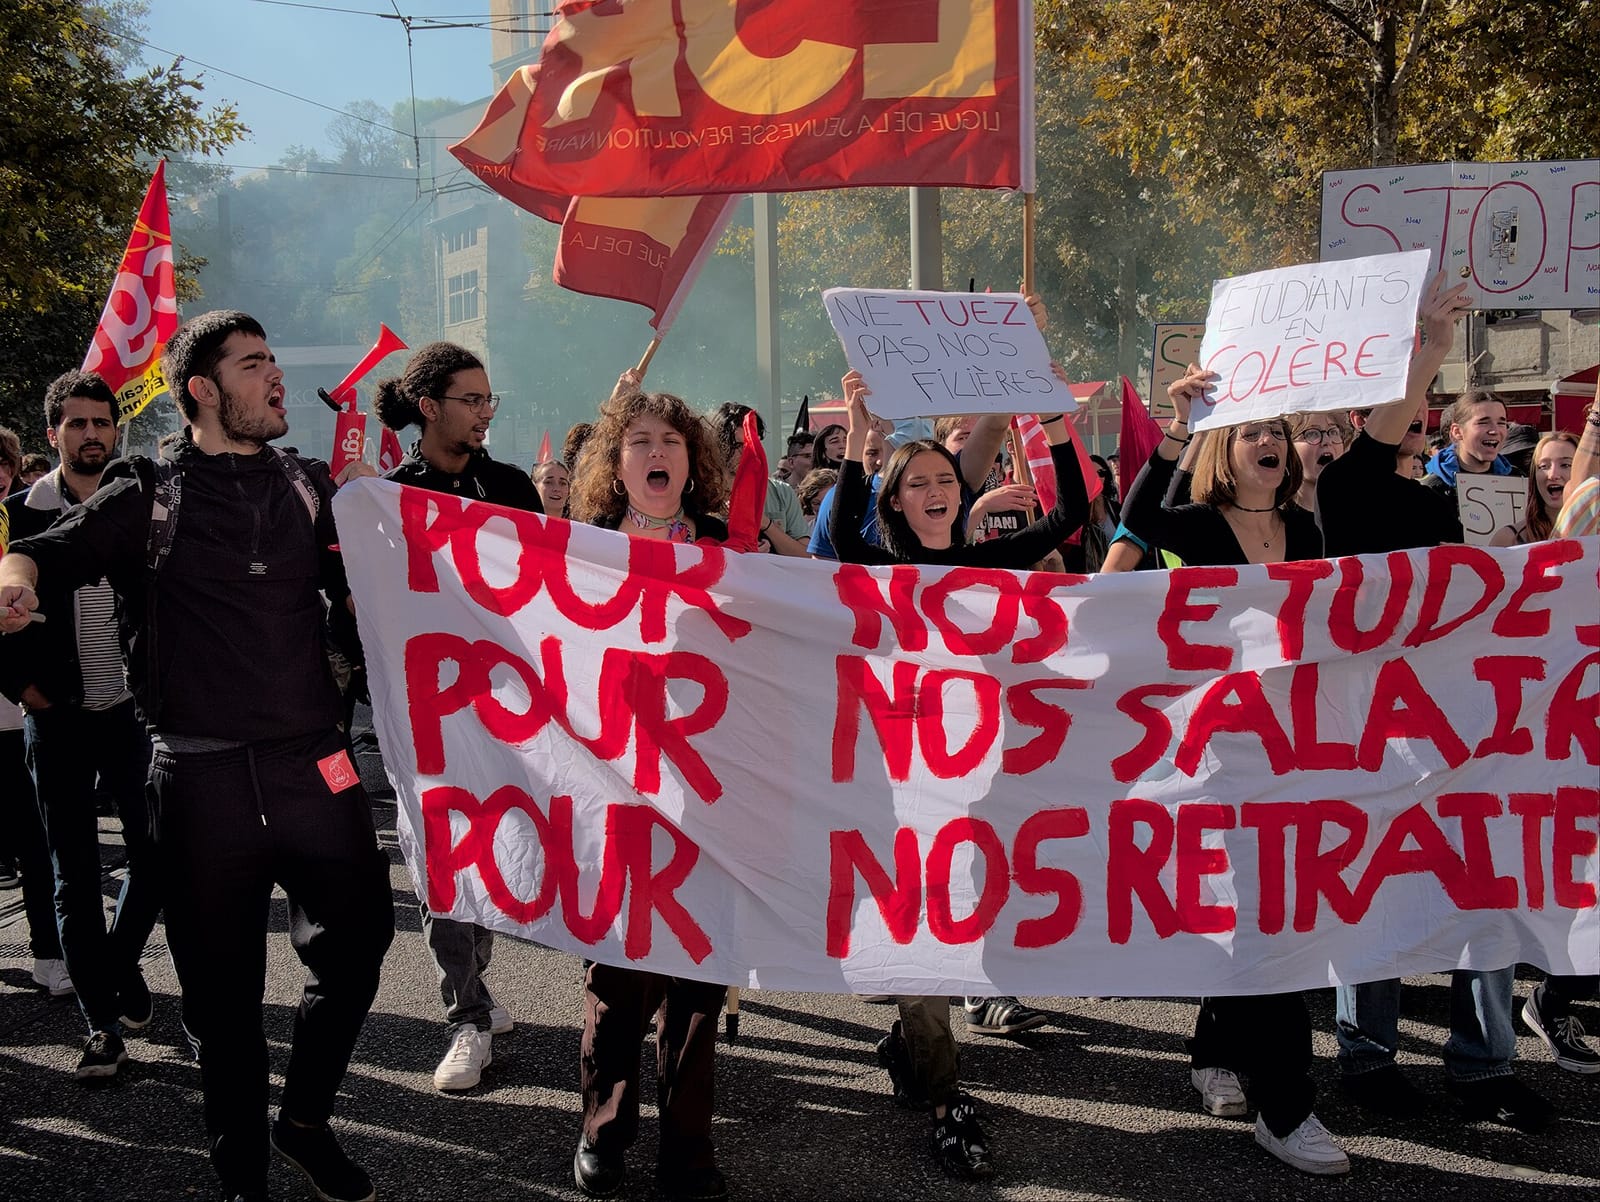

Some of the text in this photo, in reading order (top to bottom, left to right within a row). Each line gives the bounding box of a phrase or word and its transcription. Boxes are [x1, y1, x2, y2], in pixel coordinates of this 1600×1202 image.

[834, 295, 1026, 327] NE TUEZ
[1284, 314, 1326, 341] EN
[857, 331, 1018, 368] PAS NOS
[1200, 334, 1391, 407] COLÈRE
[341, 427, 361, 462] cgt
[400, 484, 1600, 672] POUR NOS ETUDE
[405, 631, 729, 805] POUR
[831, 654, 1095, 784] NOS
[421, 785, 1600, 965] POUR NOS RETRAITE
